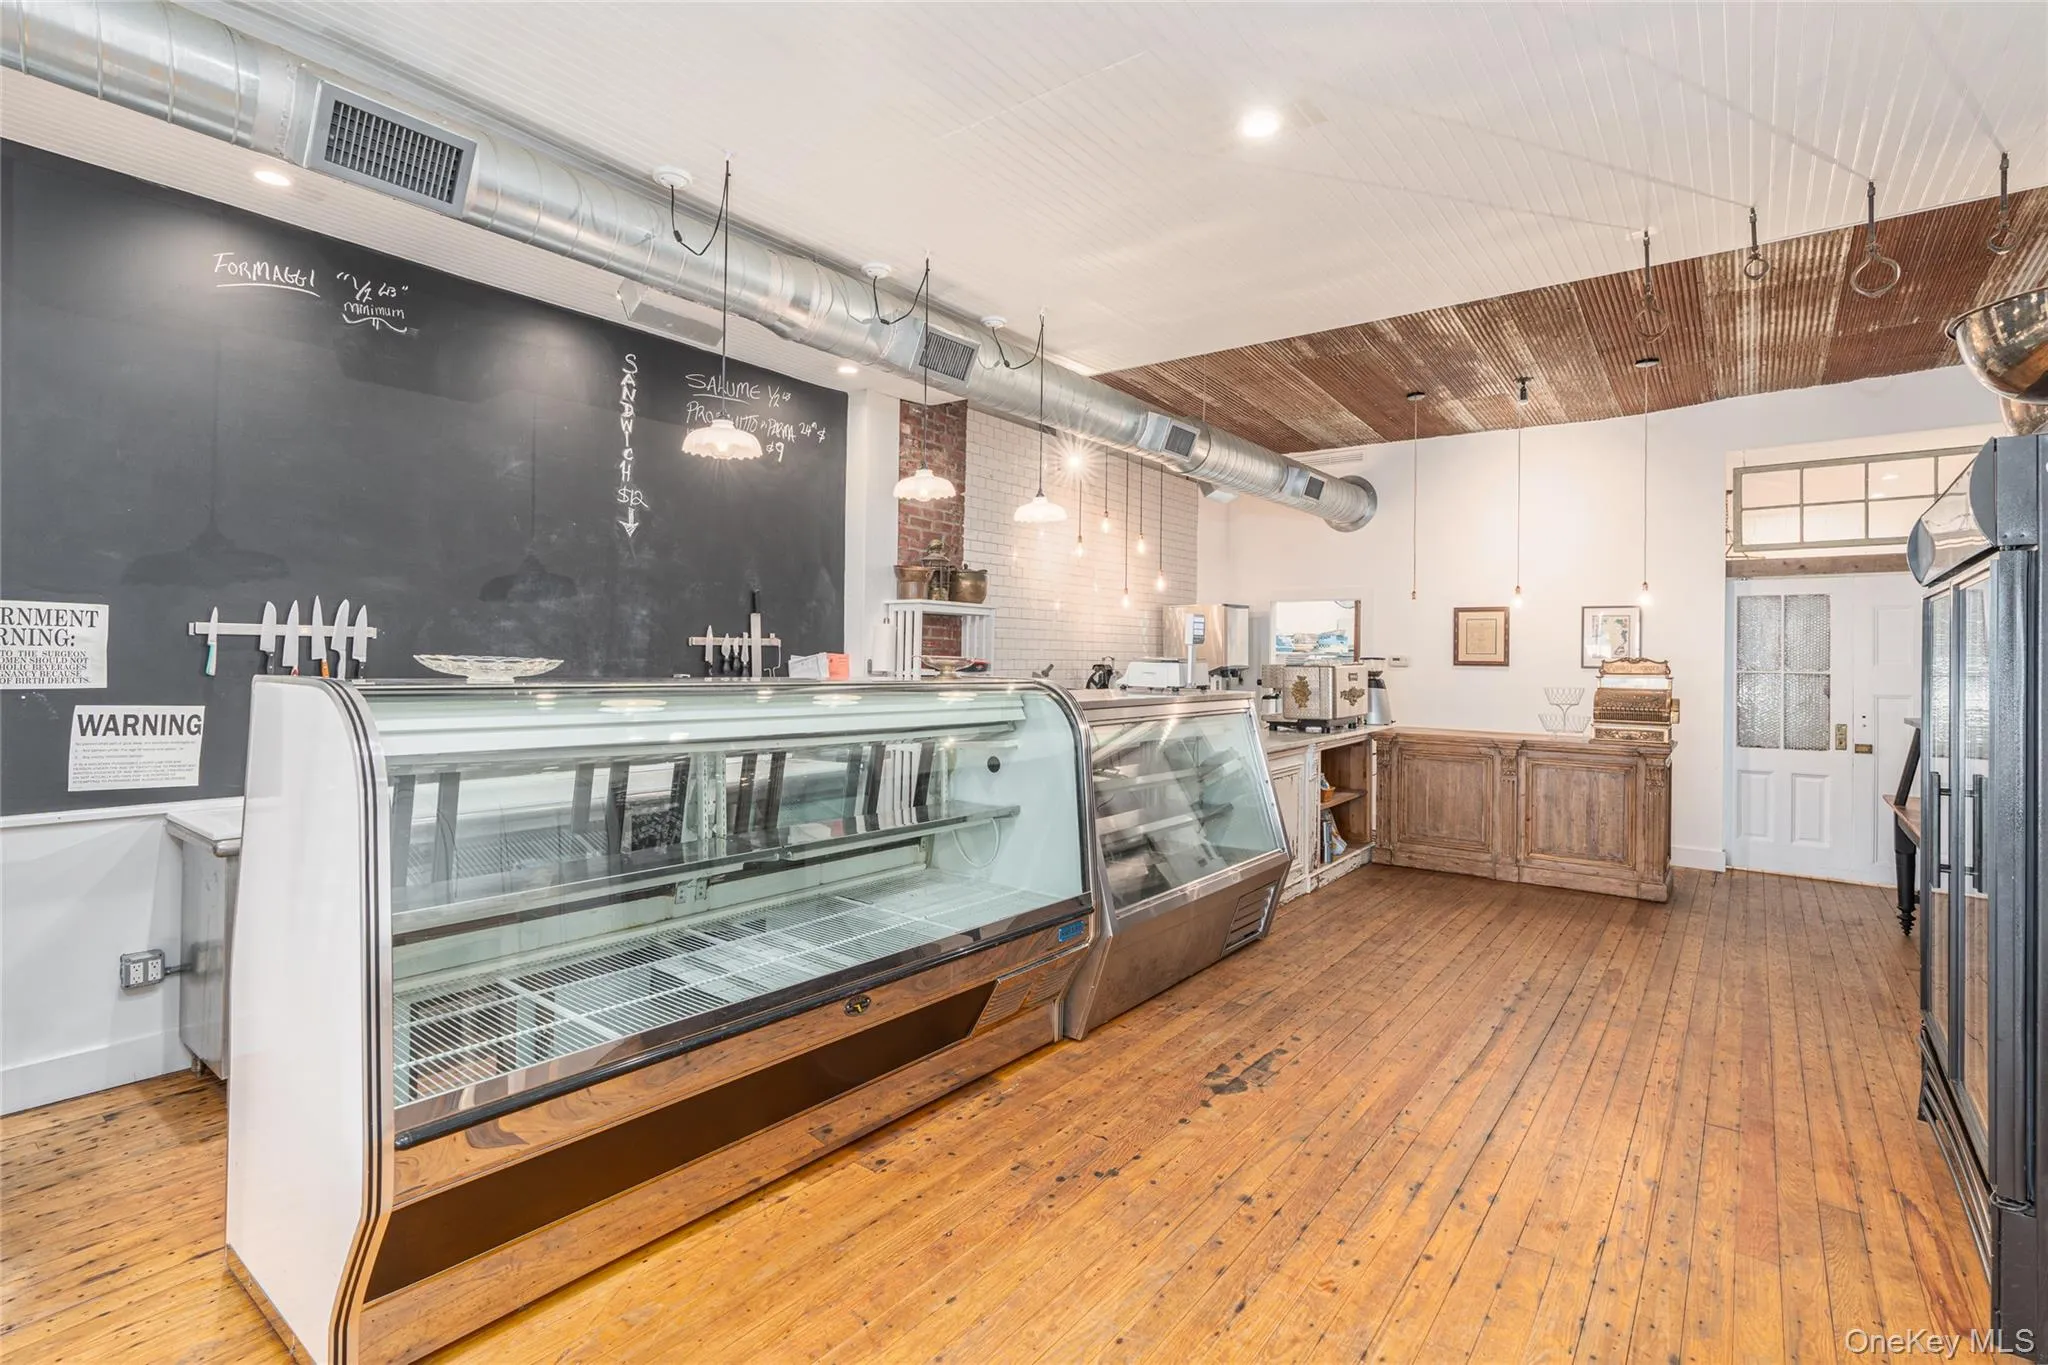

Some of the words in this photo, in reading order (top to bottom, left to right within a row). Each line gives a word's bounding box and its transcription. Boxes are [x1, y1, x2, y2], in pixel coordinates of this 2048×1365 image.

[213, 252, 316, 288] FORMAGGI
[685, 373, 761, 400] SALUME
[619, 353, 638, 482] SANDWICH
[0, 607, 99, 628] RNMENT
[18, 650, 37, 658] THE
[42, 650, 87, 658] SURGEON
[32, 663, 88, 671] BEVERAGES
[40, 670, 81, 678] BECAUSE
[77, 713, 202, 737] WARNING
